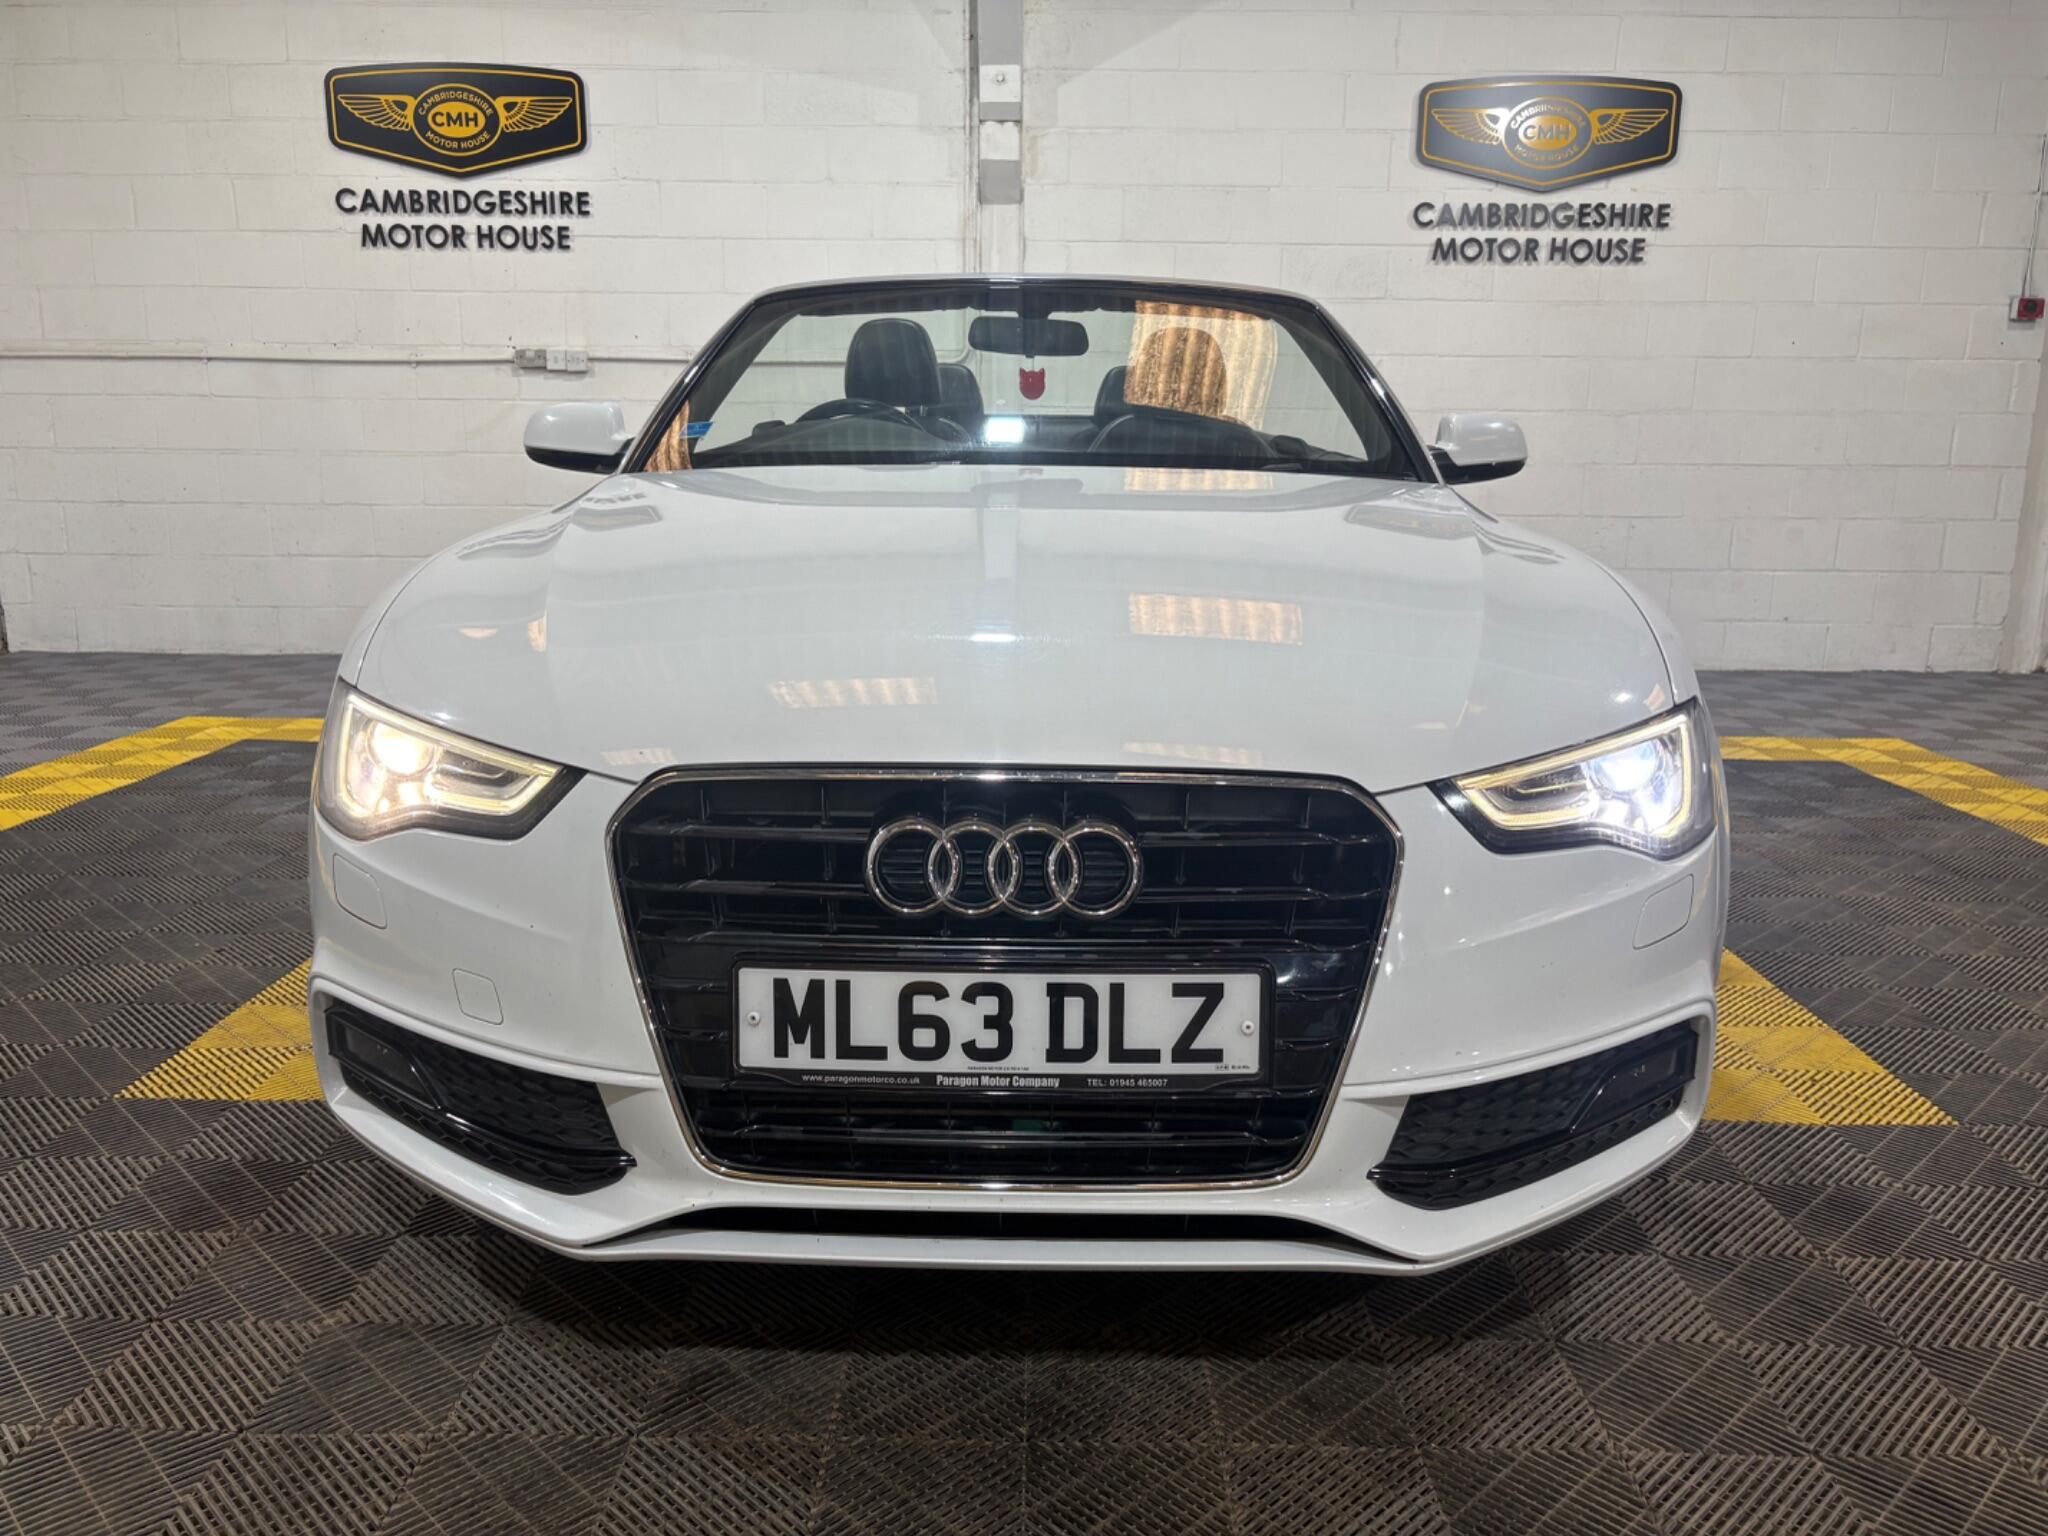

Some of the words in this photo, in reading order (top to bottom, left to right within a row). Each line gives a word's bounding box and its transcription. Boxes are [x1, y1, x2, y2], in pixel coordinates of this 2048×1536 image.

[418, 91, 494, 116] CAMBRIDGESHIRE
[431, 111, 479, 128] CMH
[425, 131, 458, 149] MOTOR
[460, 131, 491, 149] HOUSE
[1522, 125, 1571, 141] CMH
[335, 187, 591, 216] CAMBRIDGESHIRE
[1412, 201, 1672, 229] CAMBRIDGESHIRE
[361, 223, 466, 249] MOTOR
[477, 225, 571, 250] HOUSE
[1431, 237, 1540, 264] MOTOR
[1549, 238, 1646, 264] HOUSE
[773, 977, 1014, 1063] ML63
[1045, 982, 1225, 1064] DLZ
[936, 1075, 979, 1087] Paragon
[980, 1075, 1010, 1087] Motor
[1011, 1075, 1060, 1088] Company
[1087, 1078, 1107, 1087] TEL:
